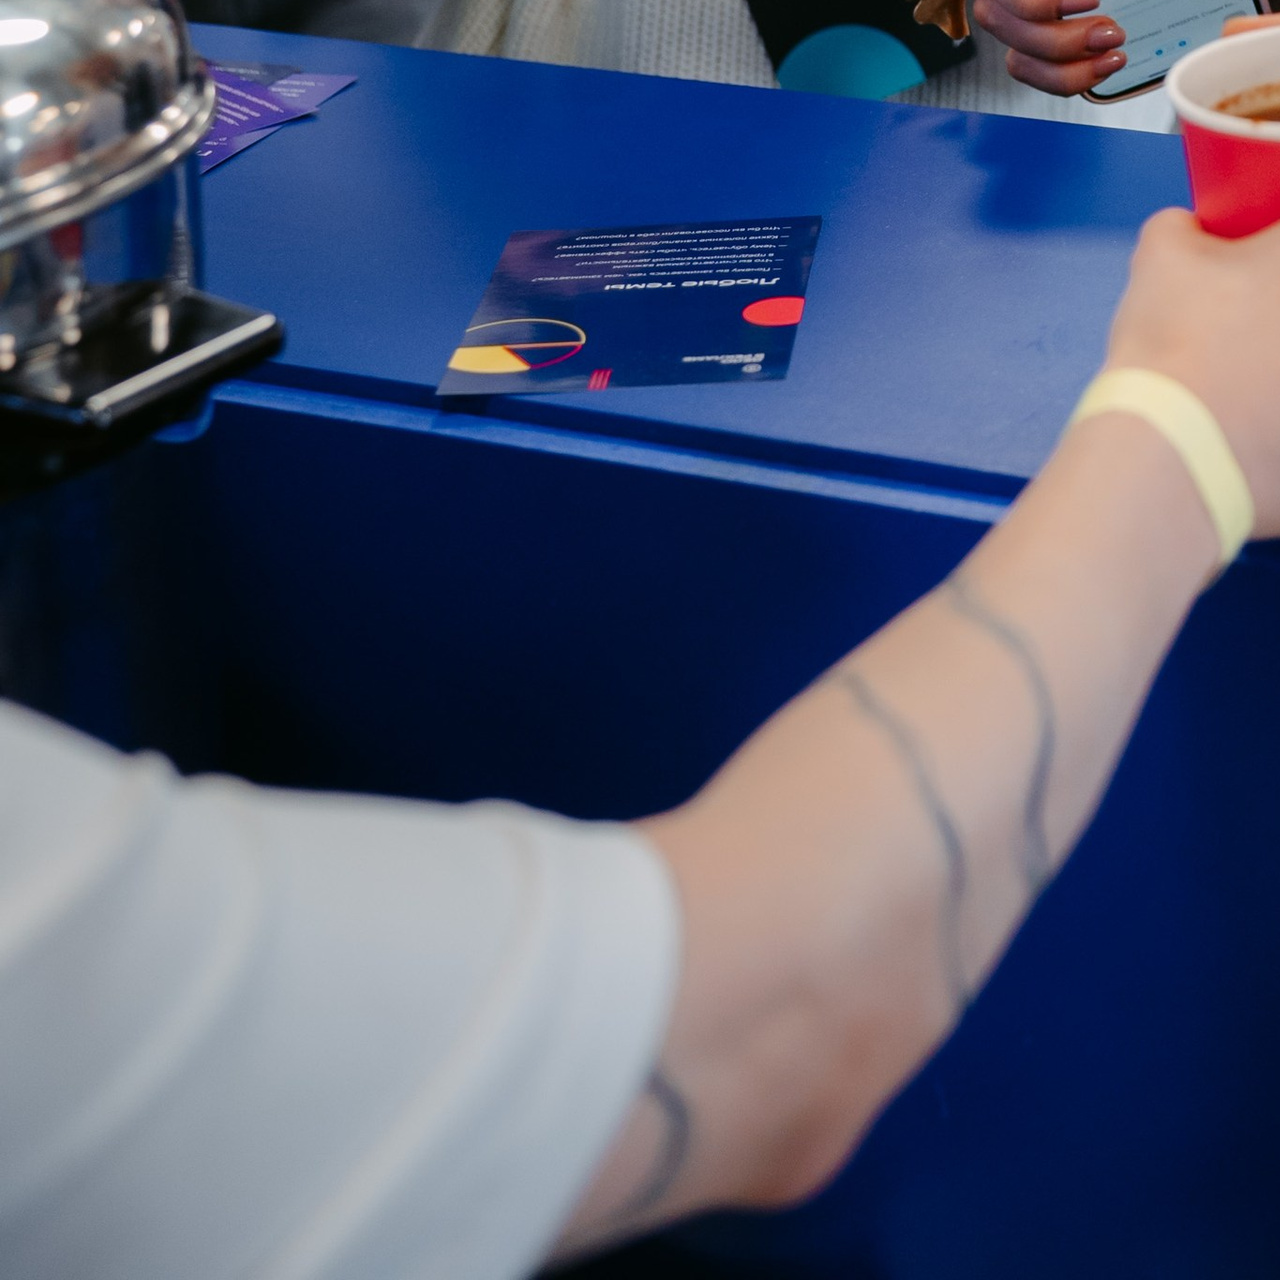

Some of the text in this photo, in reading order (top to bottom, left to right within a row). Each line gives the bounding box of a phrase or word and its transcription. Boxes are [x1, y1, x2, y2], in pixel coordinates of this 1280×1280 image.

[662, 228, 730, 236] посоветовали
[611, 239, 697, 247] каналы/блогеров
[576, 258, 651, 266] деятельности?
[652, 253, 766, 263] предпринимательской
[604, 277, 780, 290] Любые темы
